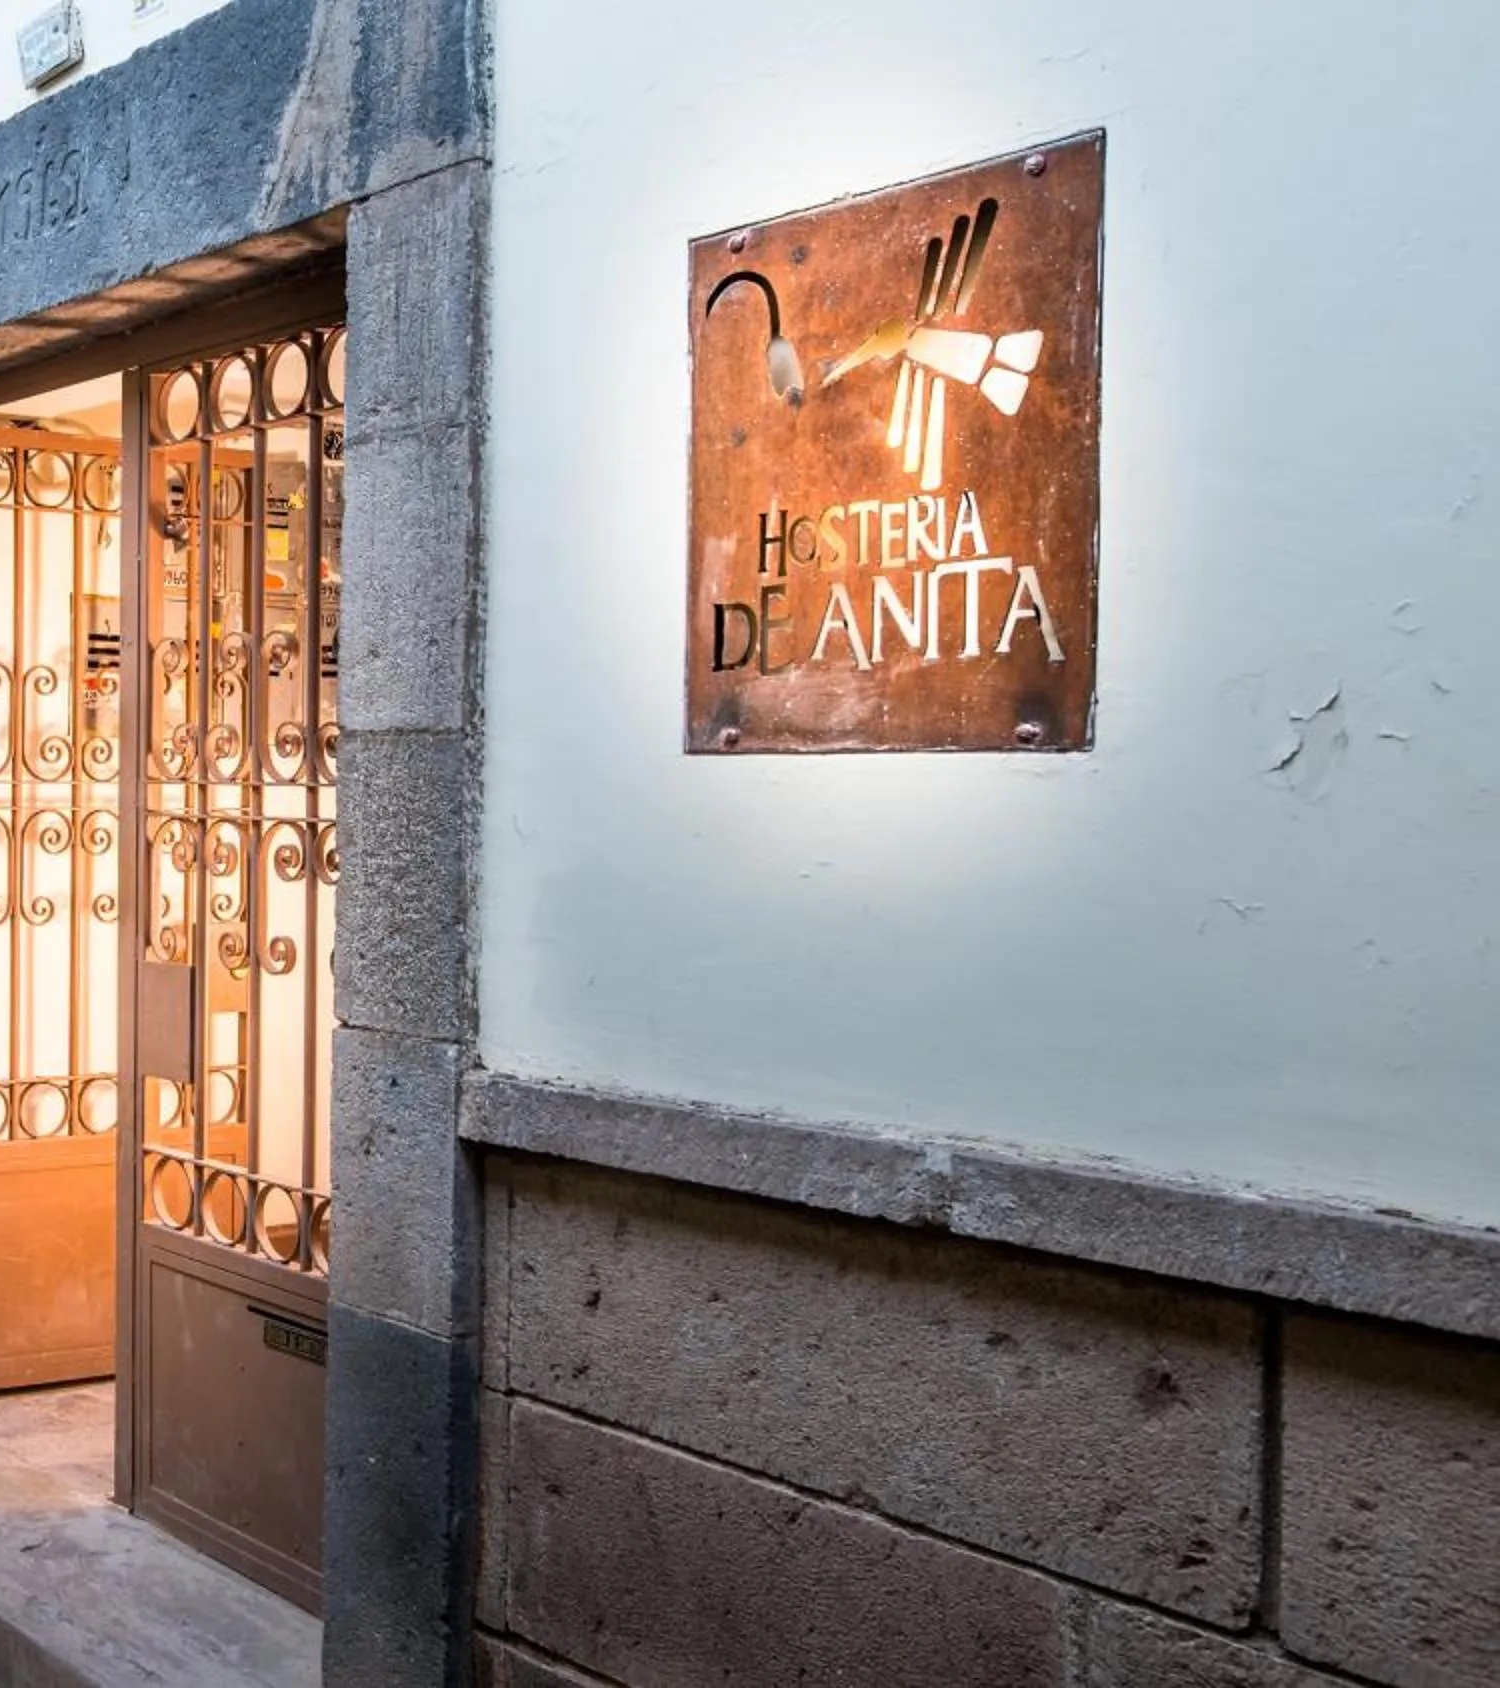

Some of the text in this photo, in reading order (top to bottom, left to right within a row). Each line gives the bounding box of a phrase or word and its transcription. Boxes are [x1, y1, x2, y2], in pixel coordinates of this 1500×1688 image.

[758, 490, 988, 577] HOSTERIA
[711, 557, 1066, 677] DE ANITA
